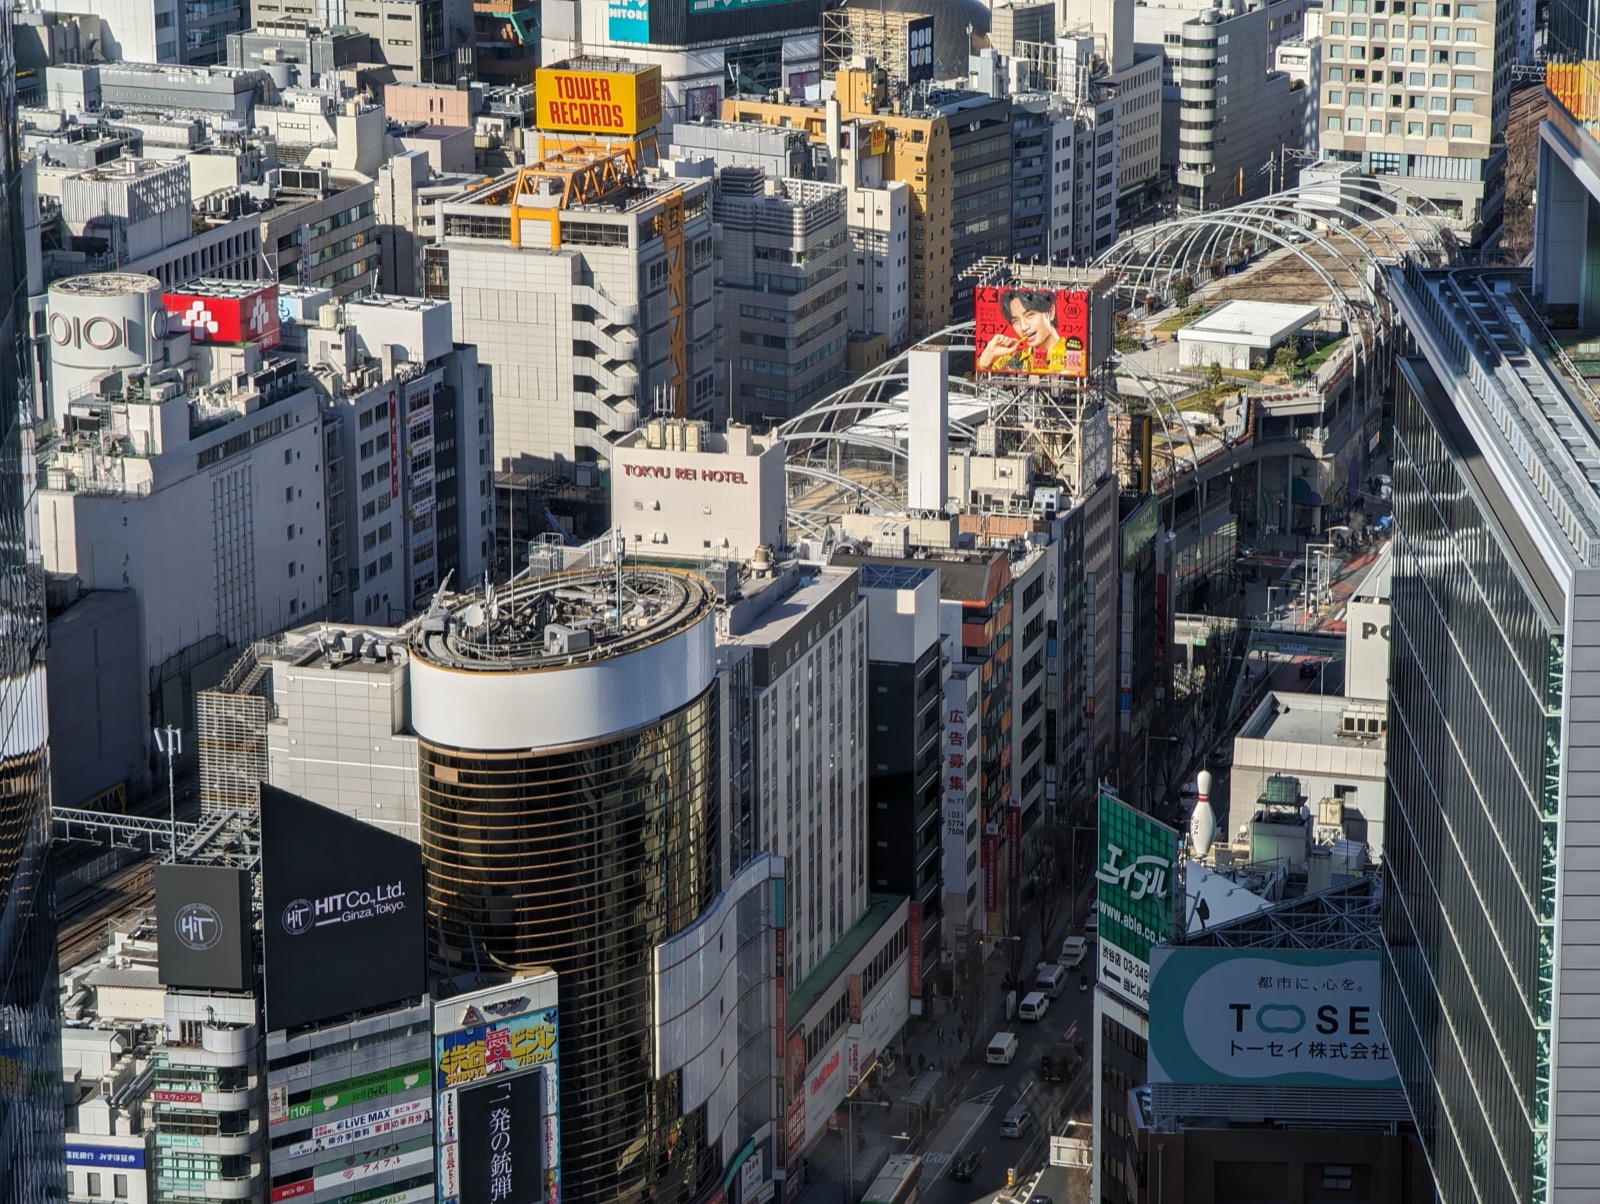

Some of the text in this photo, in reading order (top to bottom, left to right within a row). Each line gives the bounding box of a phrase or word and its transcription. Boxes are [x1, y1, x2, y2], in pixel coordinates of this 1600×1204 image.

[609, 8, 647, 20] NITORI
[554, 76, 611, 101] TOWER
[638, 78, 657, 101] TOWER
[549, 101, 624, 127] RECORDS
[637, 96, 660, 121] RECORDS
[872, 130, 884, 141] ABC
[980, 323, 1009, 335] スコーン
[1061, 324, 1083, 333] スコーン
[623, 464, 748, 485] TOKYU REI HOTEL
[949, 709, 965, 792] 広告募集
[948, 810, 964, 819] (03)
[948, 819, 965, 828] 5774
[948, 827, 965, 836] 7506
[1095, 843, 1170, 900] エイブル
[315, 893, 346, 915] HIT
[1102, 943, 1122, 968] 渋谷店
[1257, 976, 1364, 993] 都市に、心を。
[516, 1050, 553, 1067] VISION
[1230, 1040, 1390, 1061] トーセイ株式会社
[409, 1063, 429, 1073] HOUSE
[494, 1061, 505, 1072] AI
[352, 1074, 387, 1088] PITAT HOUSE
[446, 1067, 486, 1084] SHIBUYA
[328, 1083, 348, 1093] HOUSE
[163, 1094, 200, 1102] スヴェンソン
[411, 1102, 421, 1110] 9F
[294, 1105, 312, 1118] 10F
[368, 1109, 391, 1123] MAX
[374, 1113, 423, 1134] 家賃の半月分
[328, 1128, 370, 1145] 仲介手数料
[99, 1152, 135, 1163] みずほ証券
[363, 1144, 400, 1160] アイフル
[363, 1157, 401, 1173] アイフル
